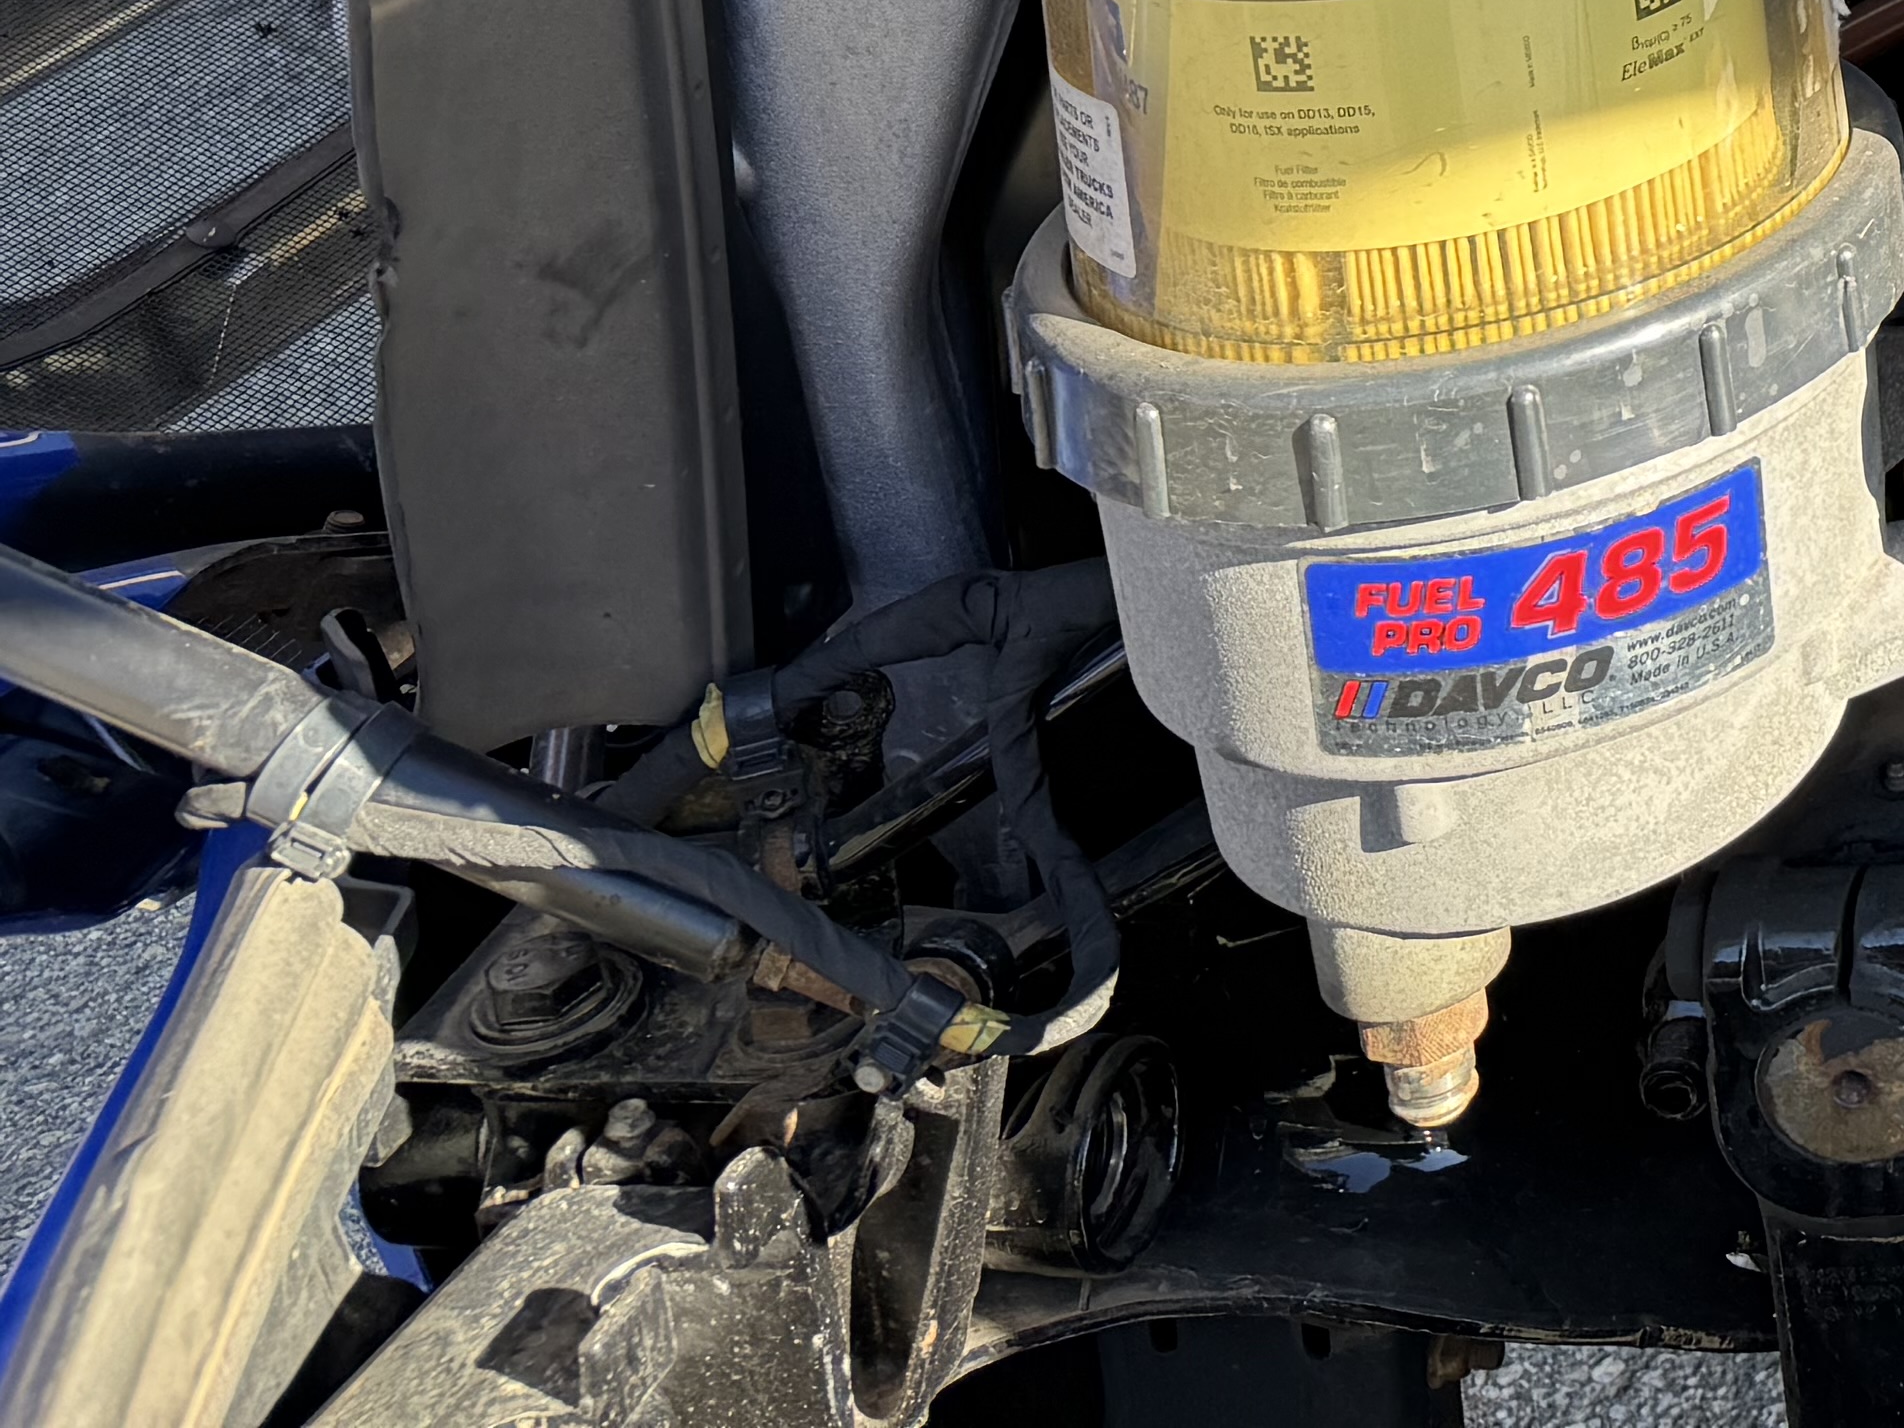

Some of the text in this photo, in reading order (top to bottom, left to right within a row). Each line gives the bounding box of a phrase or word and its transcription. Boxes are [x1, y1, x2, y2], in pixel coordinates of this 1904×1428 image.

[1621, 43, 1685, 81] EleMax
[1213, 105, 1236, 119] Only
[1257, 111, 1277, 119] use
[1280, 111, 1295, 119] on
[1297, 108, 1334, 120] DD13,
[1337, 105, 1375, 117] DD15,
[1287, 124, 1360, 138] applications
[1073, 181, 1114, 220] AMERICA
[1075, 165, 1114, 199] TRUCKS
[1510, 490, 1731, 640] 485
[1354, 575, 1486, 620] FUEL
[1371, 615, 1483, 657] PRO
[1627, 613, 1735, 670] 800-328-2611
[1386, 646, 1615, 718] DAVCO
[1630, 663, 1670, 685] Made
[1677, 654, 1690, 668] in
